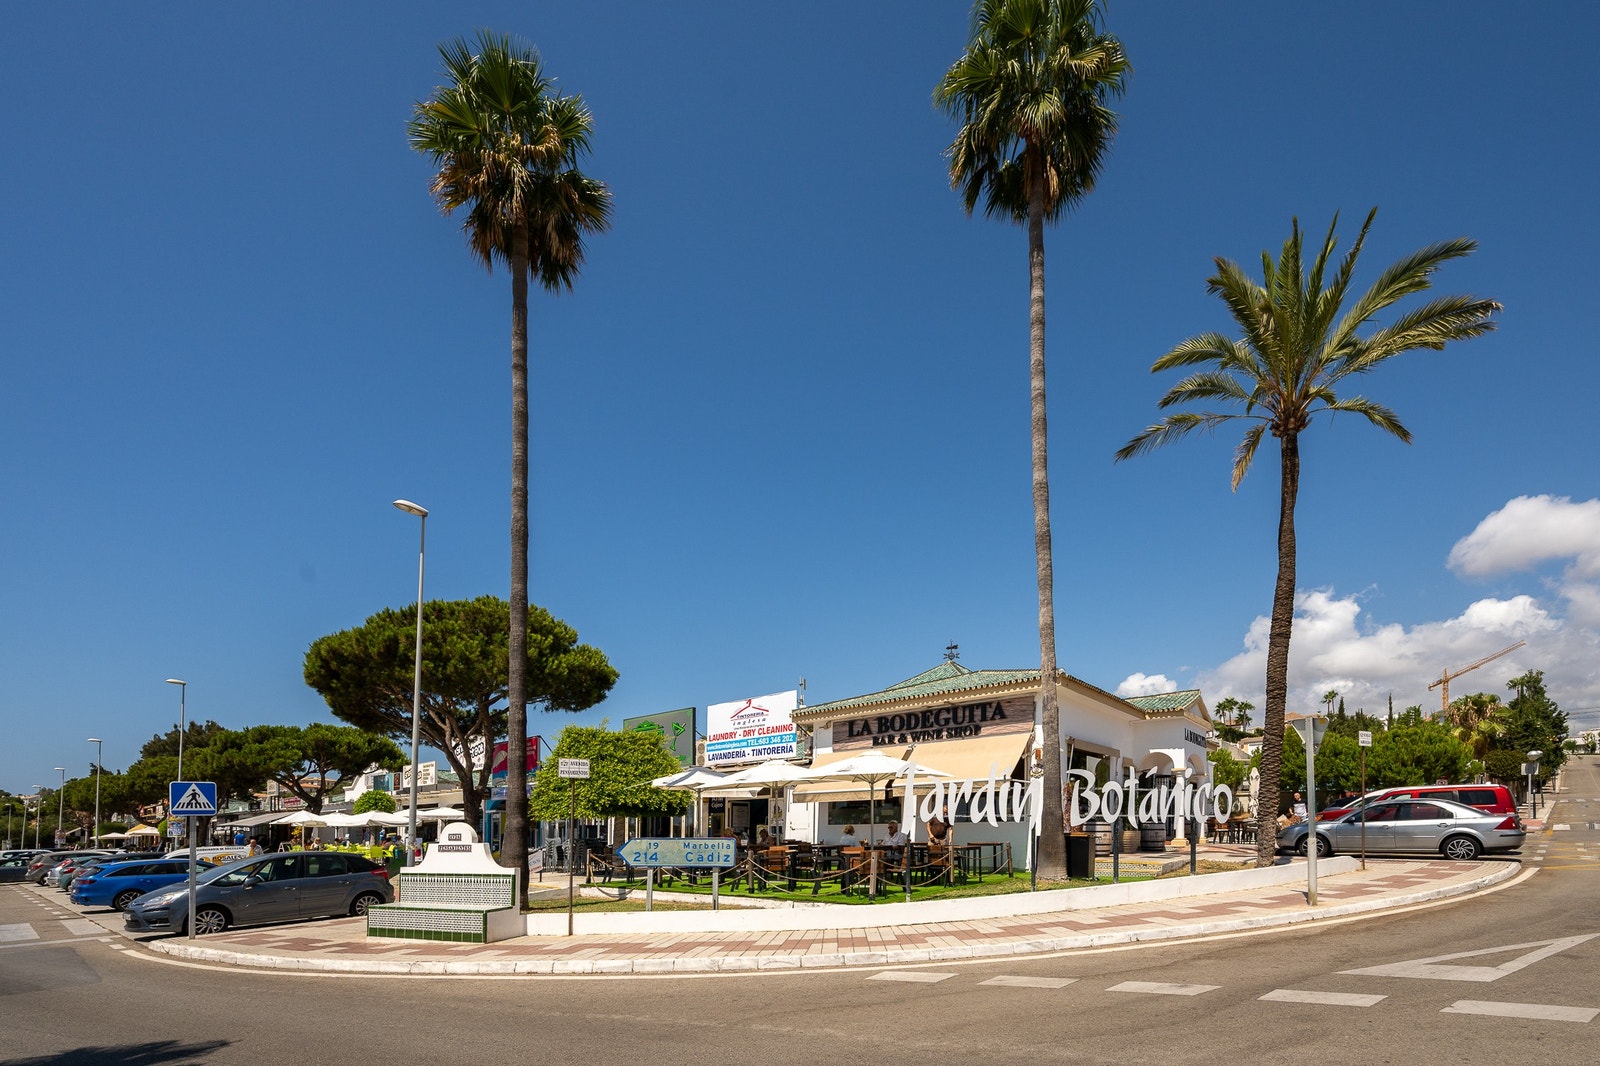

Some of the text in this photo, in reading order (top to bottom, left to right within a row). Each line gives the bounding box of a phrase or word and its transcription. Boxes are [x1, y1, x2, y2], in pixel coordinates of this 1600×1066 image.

[847, 701, 1007, 738] LA BODEGUITA
[708, 731, 738, 742] LAUNDRY
[743, 728, 757, 738] DRY
[757, 723, 794, 736] CLEANING
[872, 724, 982, 747] BAR & WINE SHOP
[1066, 765, 1233, 830] Botánico
[633, 851, 659, 862] 214
[648, 842, 731, 850] 19 Marbella
